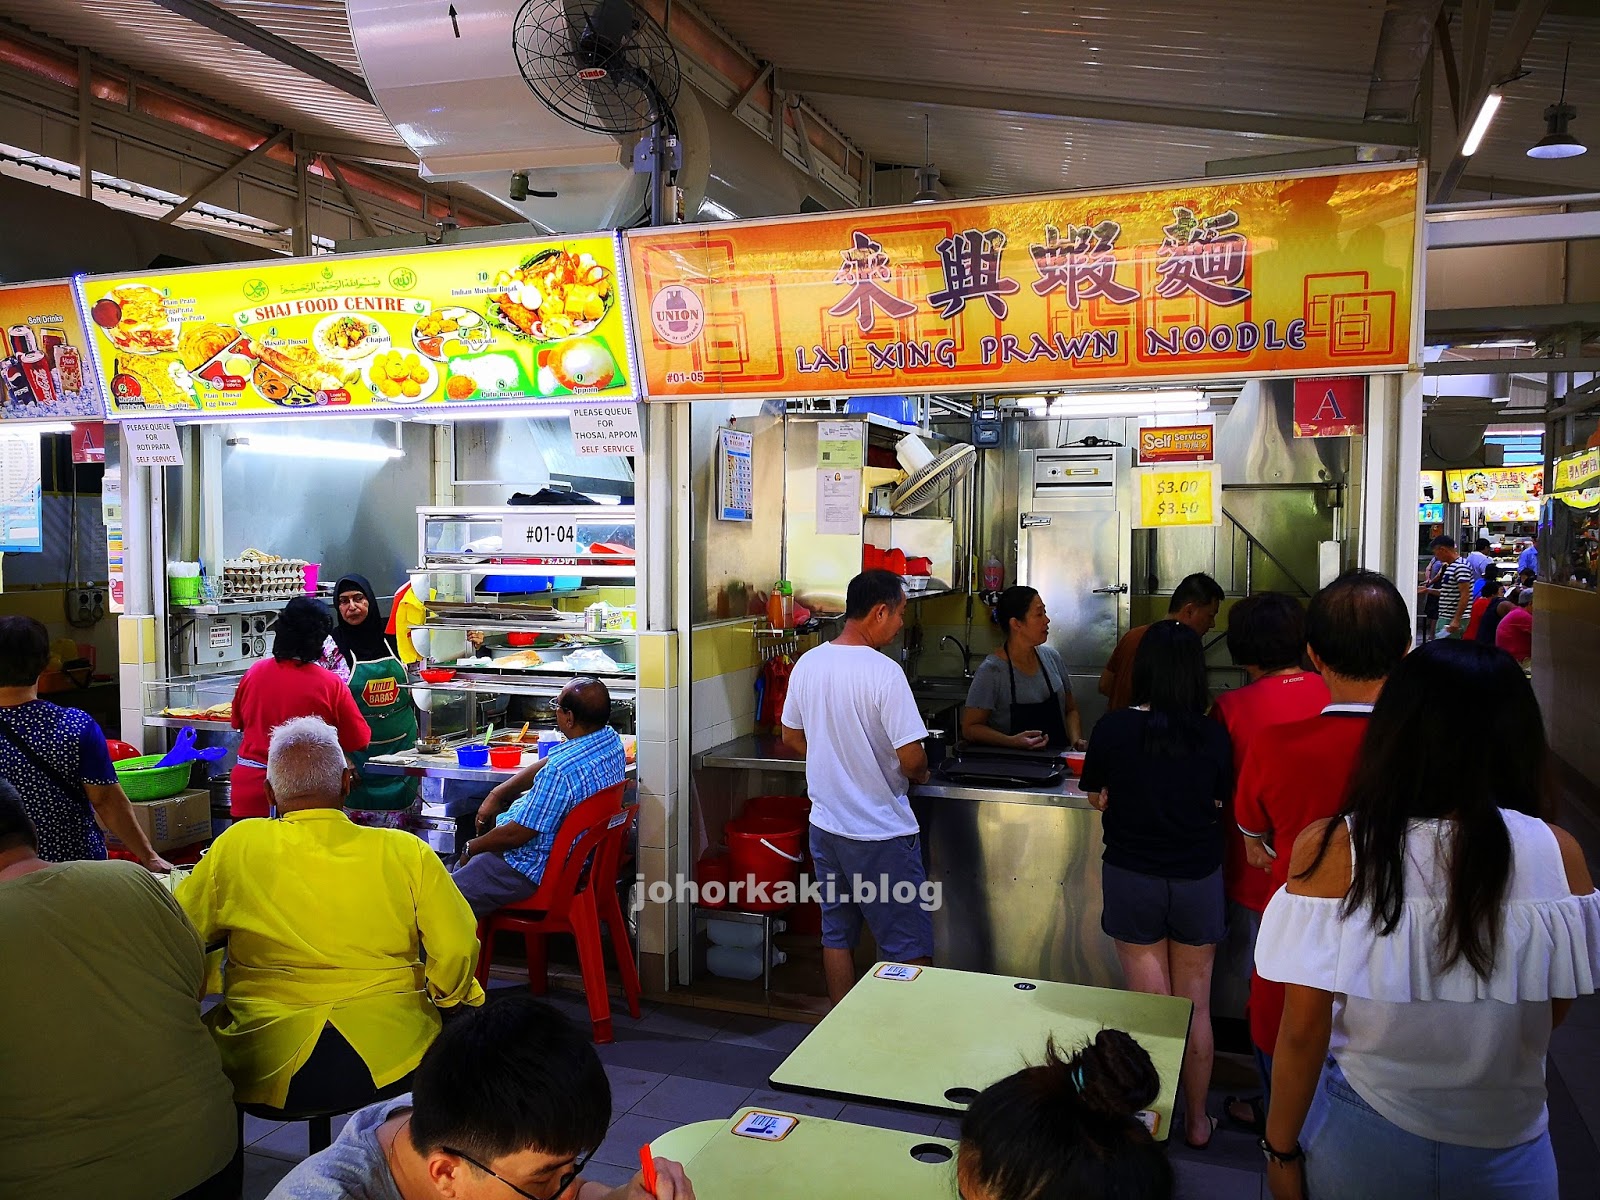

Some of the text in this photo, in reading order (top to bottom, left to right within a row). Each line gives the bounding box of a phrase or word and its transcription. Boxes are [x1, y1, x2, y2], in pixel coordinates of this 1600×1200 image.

[478, 272, 488, 280] 10
[255, 296, 406, 321] SHAJ FOOD CENTRE
[28, 314, 64, 325] Soft Drinks
[656, 309, 699, 322] UNION
[797, 319, 1306, 372] LAI XING PRAWN NOODLE
[667, 372, 704, 383] #01-05
[1312, 389, 1346, 420] A
[574, 408, 632, 417] PLEASE QUEUE
[149, 423, 171, 431] QUEUE
[597, 420, 614, 428] FOR
[80, 429, 95, 451] A
[575, 431, 638, 440] THOSAI, APPOM
[1144, 432, 1208, 450] Self Service
[603, 445, 635, 453] SERVICE
[1157, 479, 1198, 495] $3.00
[1157, 501, 1199, 516] $3.50
[526, 526, 574, 543] #01-04
